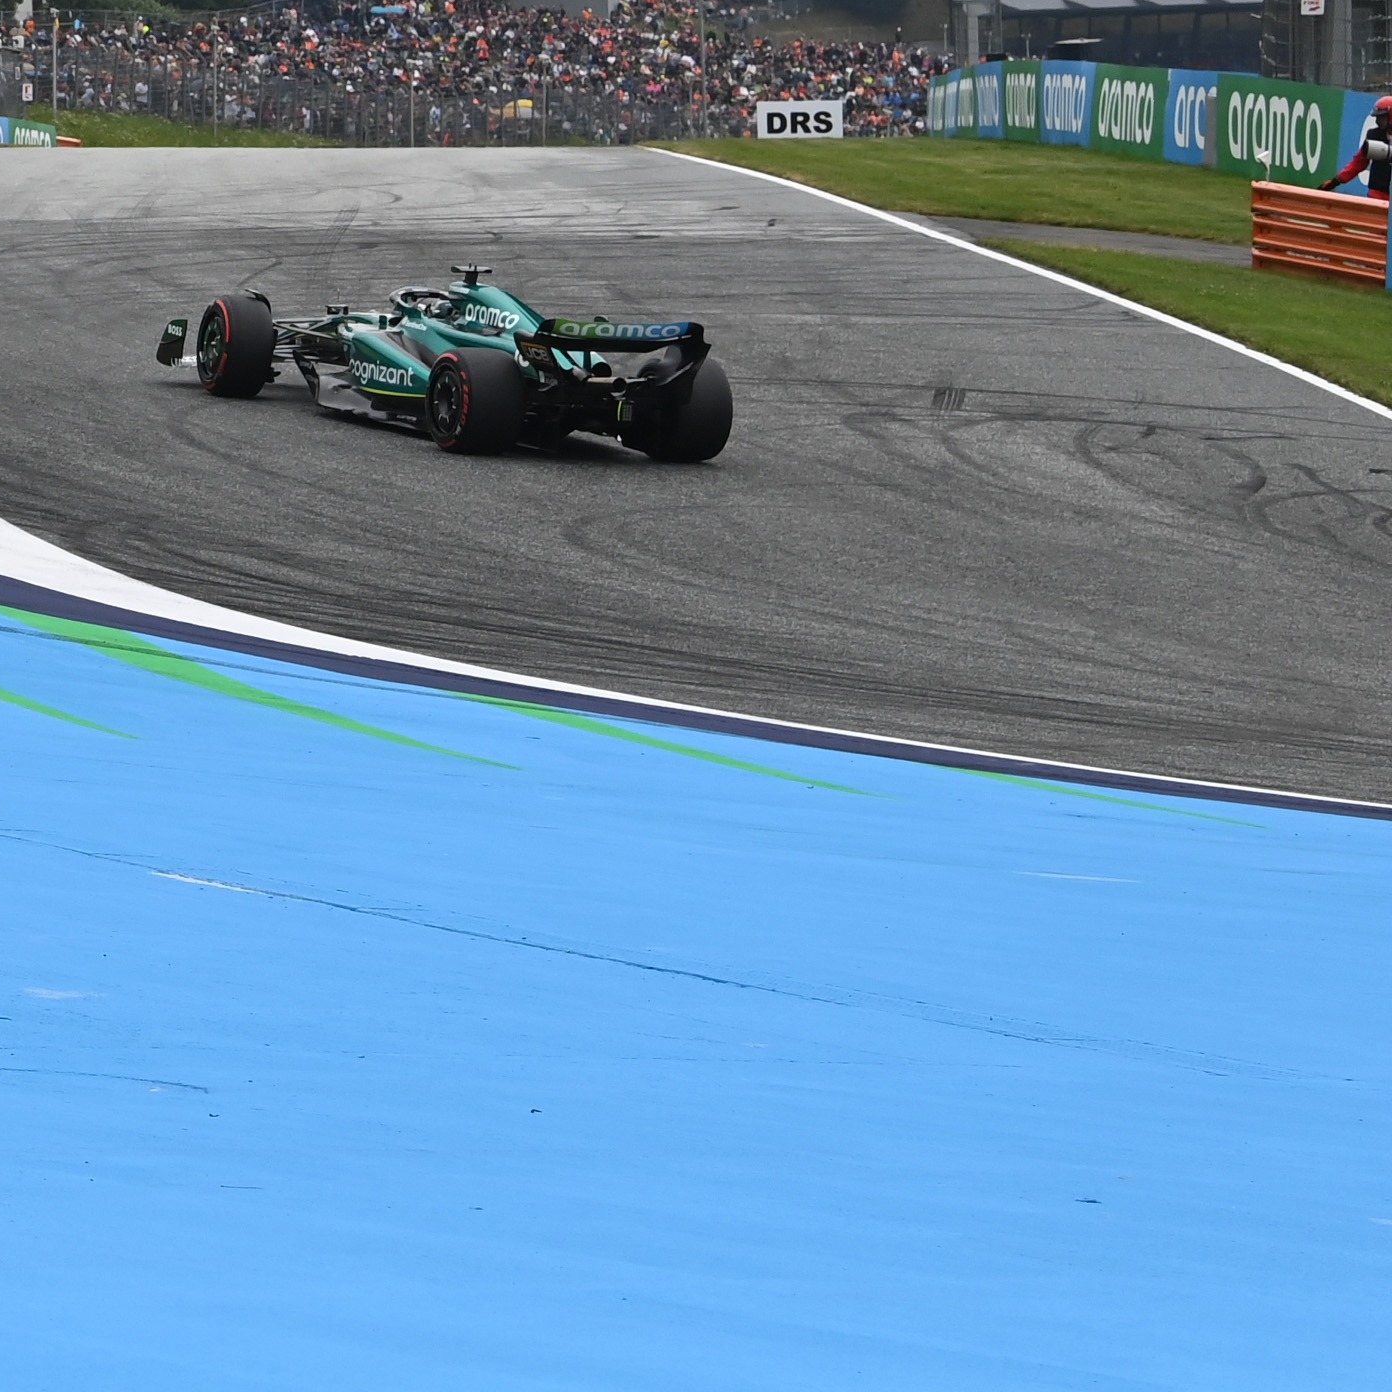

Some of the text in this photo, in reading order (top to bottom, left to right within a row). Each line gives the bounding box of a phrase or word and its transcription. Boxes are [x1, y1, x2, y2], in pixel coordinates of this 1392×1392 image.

[1044, 74, 1086, 133] aramco
[1098, 77, 1155, 145] aramco
[766, 111, 833, 134] DRS
[1228, 91, 1323, 174] aramco
[14, 126, 52, 147] aramco
[465, 303, 520, 330] aramco
[167, 323, 183, 337] BOSS
[559, 321, 682, 338] aramco
[526, 347, 549, 361] JCB
[348, 358, 414, 387] cognizant
